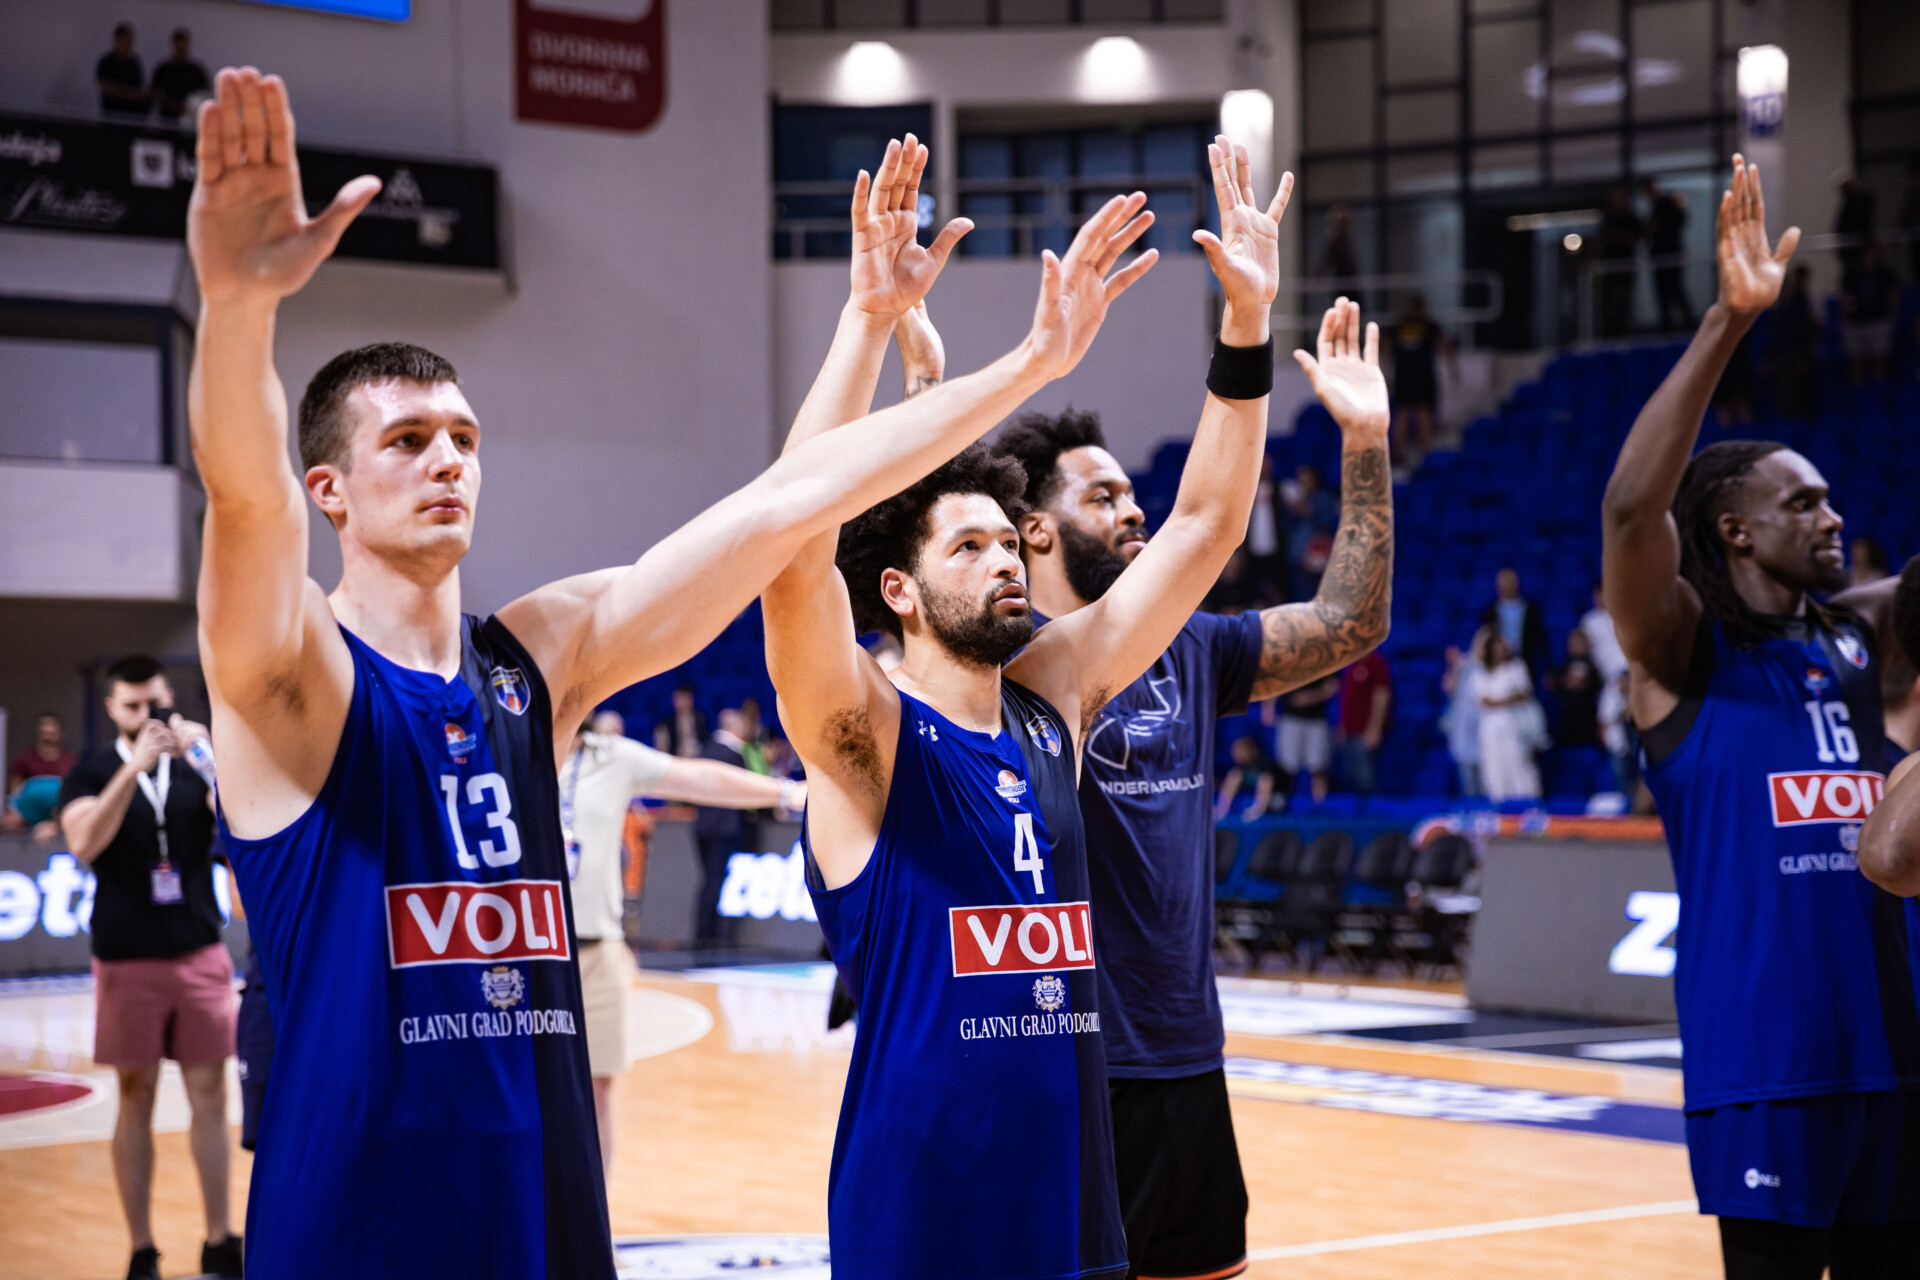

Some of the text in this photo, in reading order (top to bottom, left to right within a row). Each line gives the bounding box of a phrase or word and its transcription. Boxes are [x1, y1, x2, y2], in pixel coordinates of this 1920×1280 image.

[1804, 701, 1860, 763] 16
[440, 772, 522, 870] 13
[1013, 812, 1044, 895] 4
[406, 889, 558, 954] VOLI
[967, 910, 1093, 966] VOLI
[400, 1013, 469, 1044] GLAVNI
[472, 1011, 512, 1038] GRAD
[960, 1016, 1018, 1040] GLAVNI
[1021, 1014, 1057, 1036] GRAD
